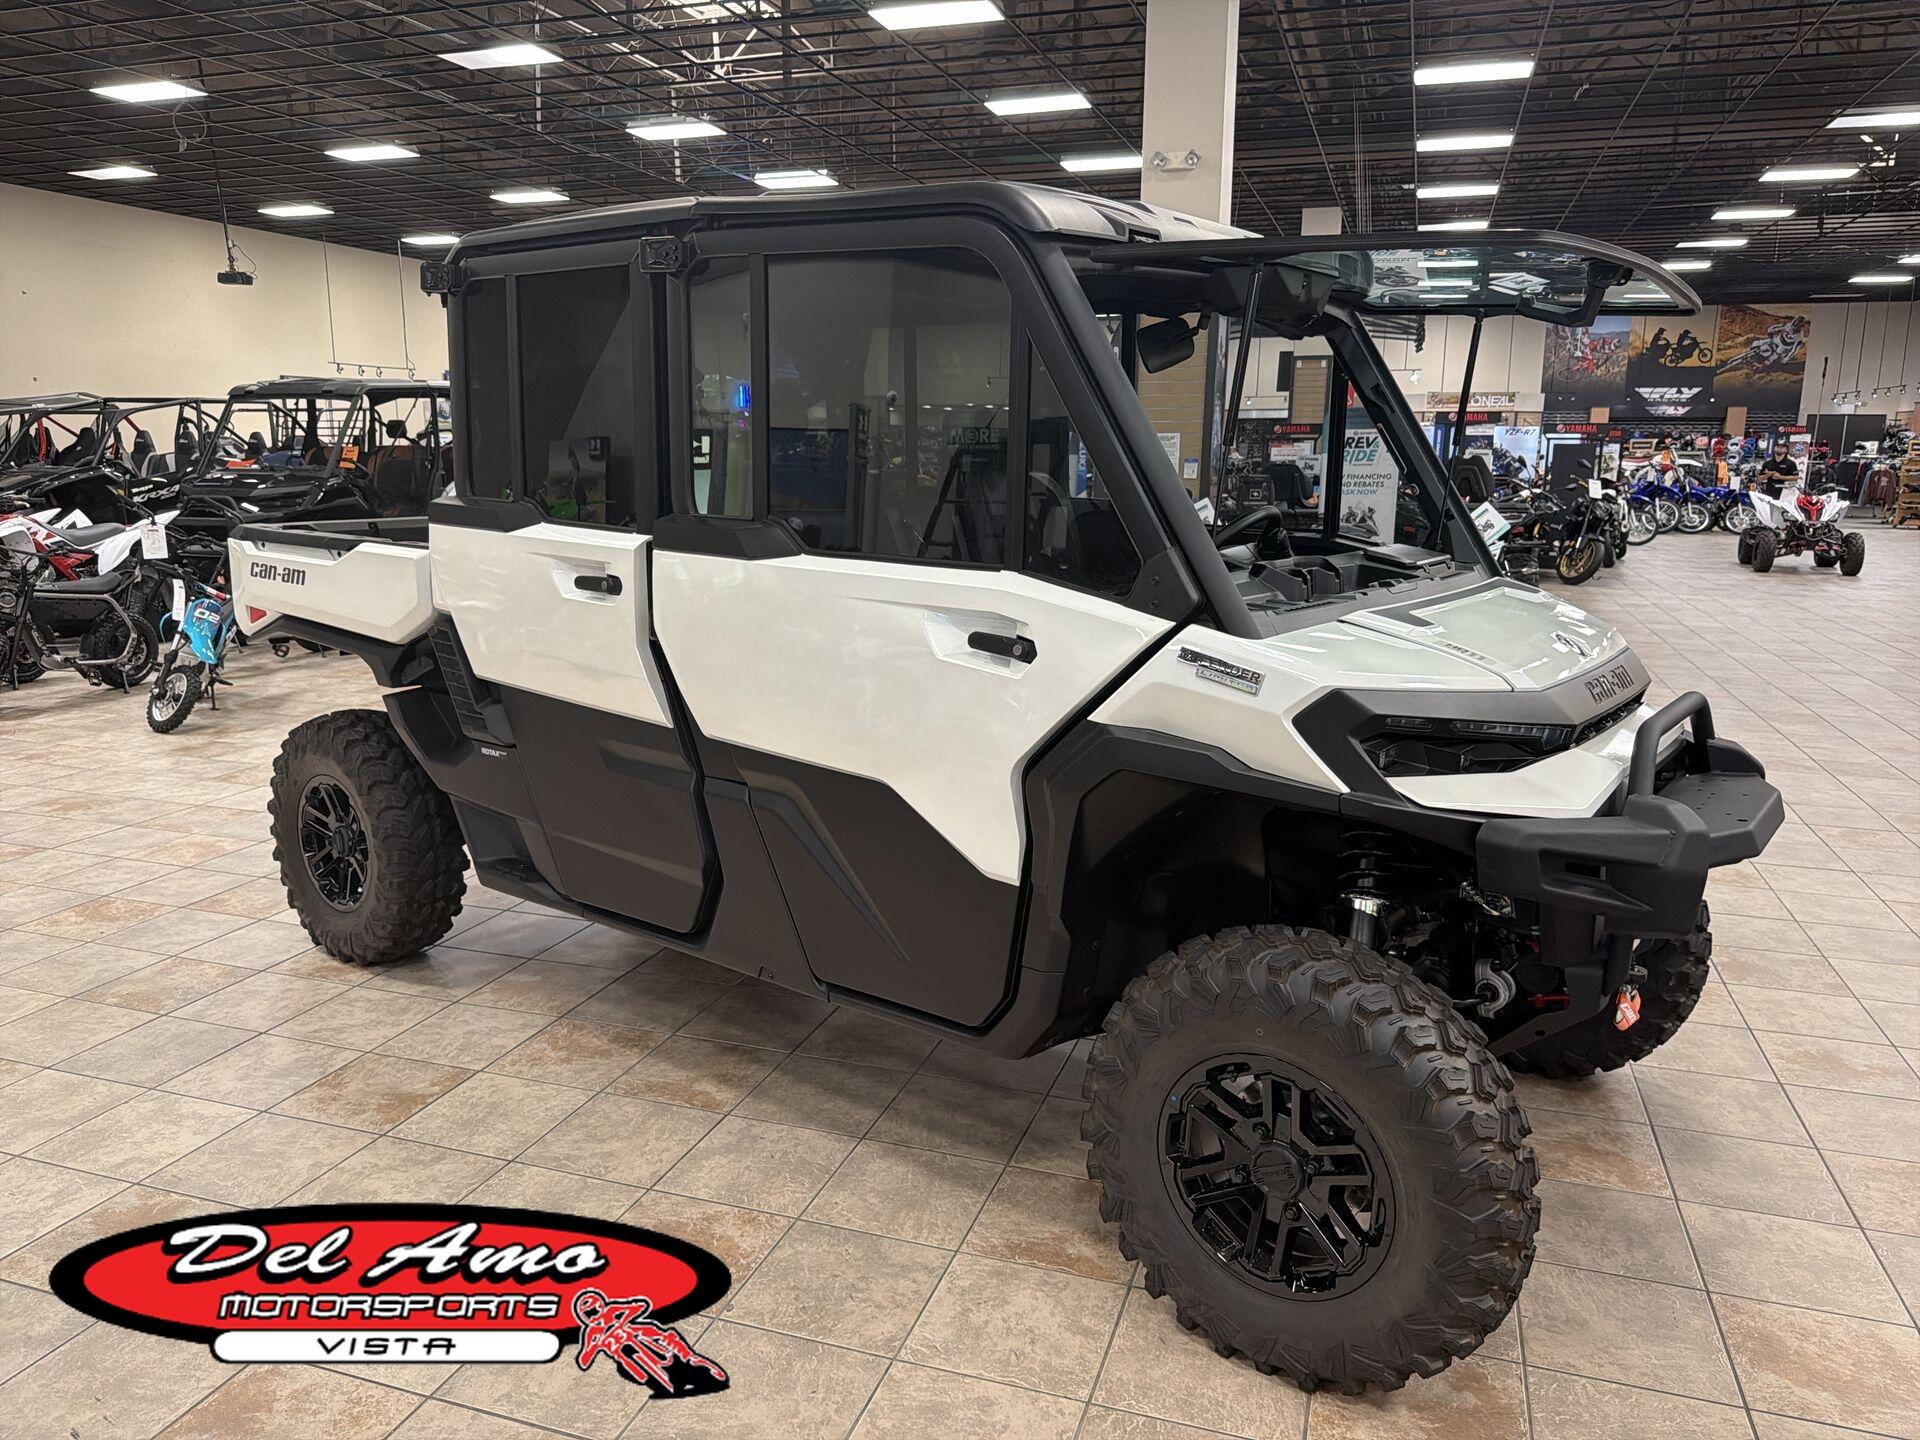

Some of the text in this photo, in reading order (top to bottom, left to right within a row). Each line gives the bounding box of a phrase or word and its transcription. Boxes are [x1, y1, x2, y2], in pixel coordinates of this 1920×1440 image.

[1634, 387, 1703, 398] FLY
[1464, 413, 1489, 422] MAHA
[1282, 425, 1312, 433] YAMAHA
[1504, 428, 1537, 436] YZF-R7
[1566, 425, 1597, 433] YAMAHA
[1344, 436, 1379, 449] REV
[250, 561, 306, 586] can-am
[1584, 664, 1635, 703] can-am
